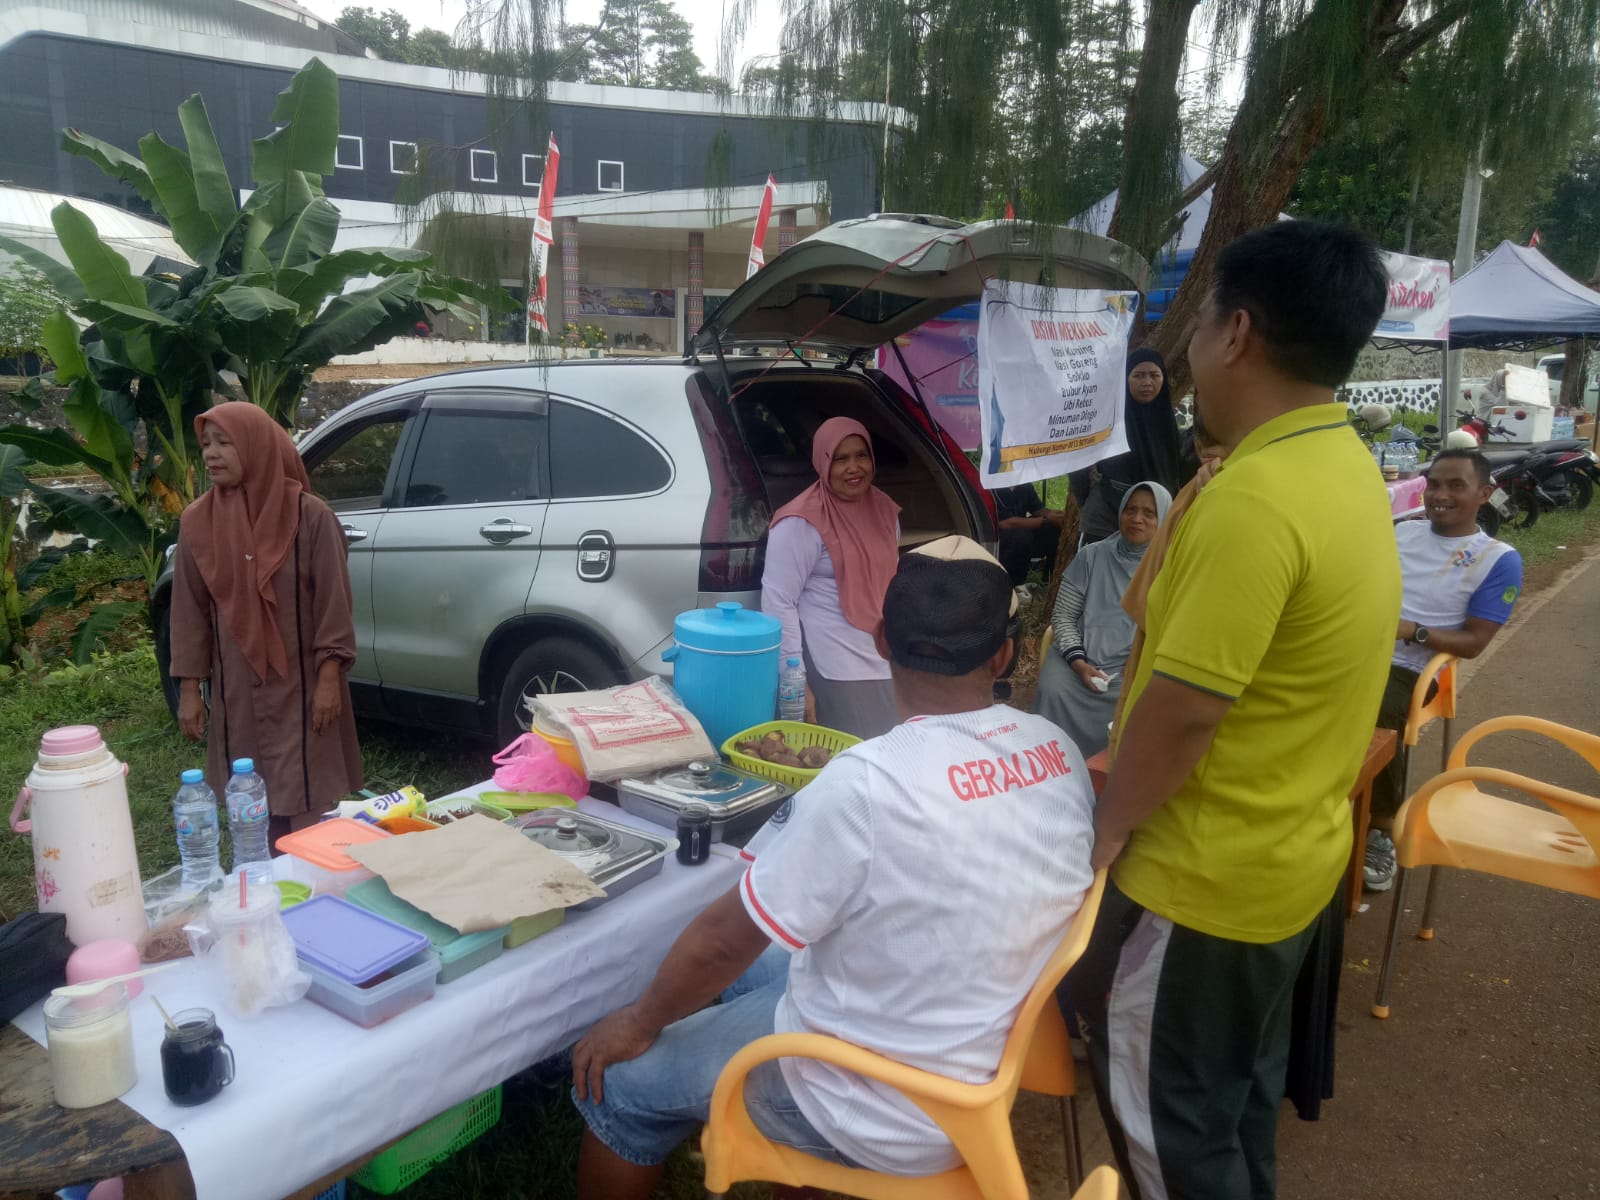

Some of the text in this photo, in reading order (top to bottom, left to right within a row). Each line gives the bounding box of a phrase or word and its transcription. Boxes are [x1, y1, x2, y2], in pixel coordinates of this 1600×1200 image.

[1066, 345, 1095, 357] Kuning
[1069, 357, 1098, 370] Goreng
[1061, 384, 1098, 398] Bubur Ayam
[1063, 400, 1075, 411] Ubi
[1047, 413, 1080, 426] Minuman
[1049, 423, 1092, 439] Dan Lain Lain
[947, 739, 1072, 801] GERALDINE
